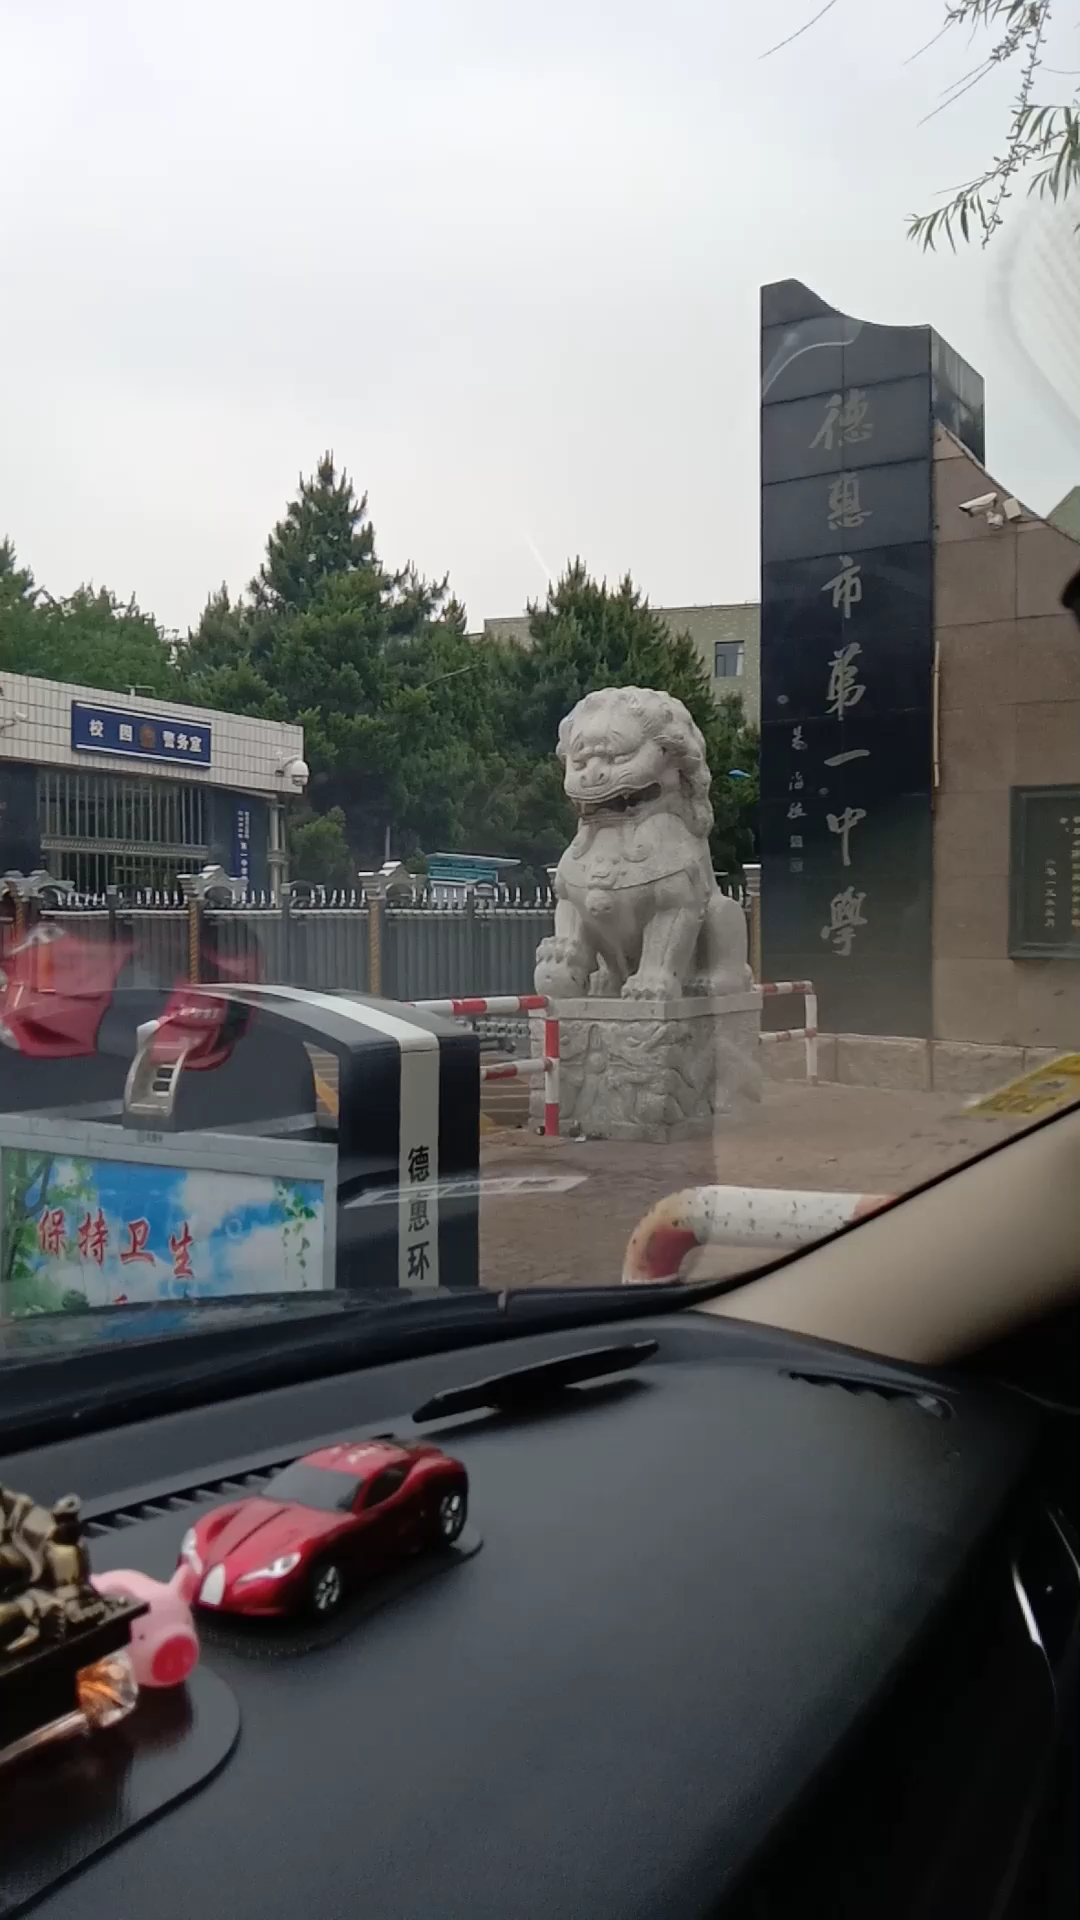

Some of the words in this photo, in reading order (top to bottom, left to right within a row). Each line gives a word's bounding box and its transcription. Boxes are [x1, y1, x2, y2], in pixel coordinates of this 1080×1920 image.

[162, 730, 202, 752] 警务室
[37, 1204, 196, 1281] 保持卫生
